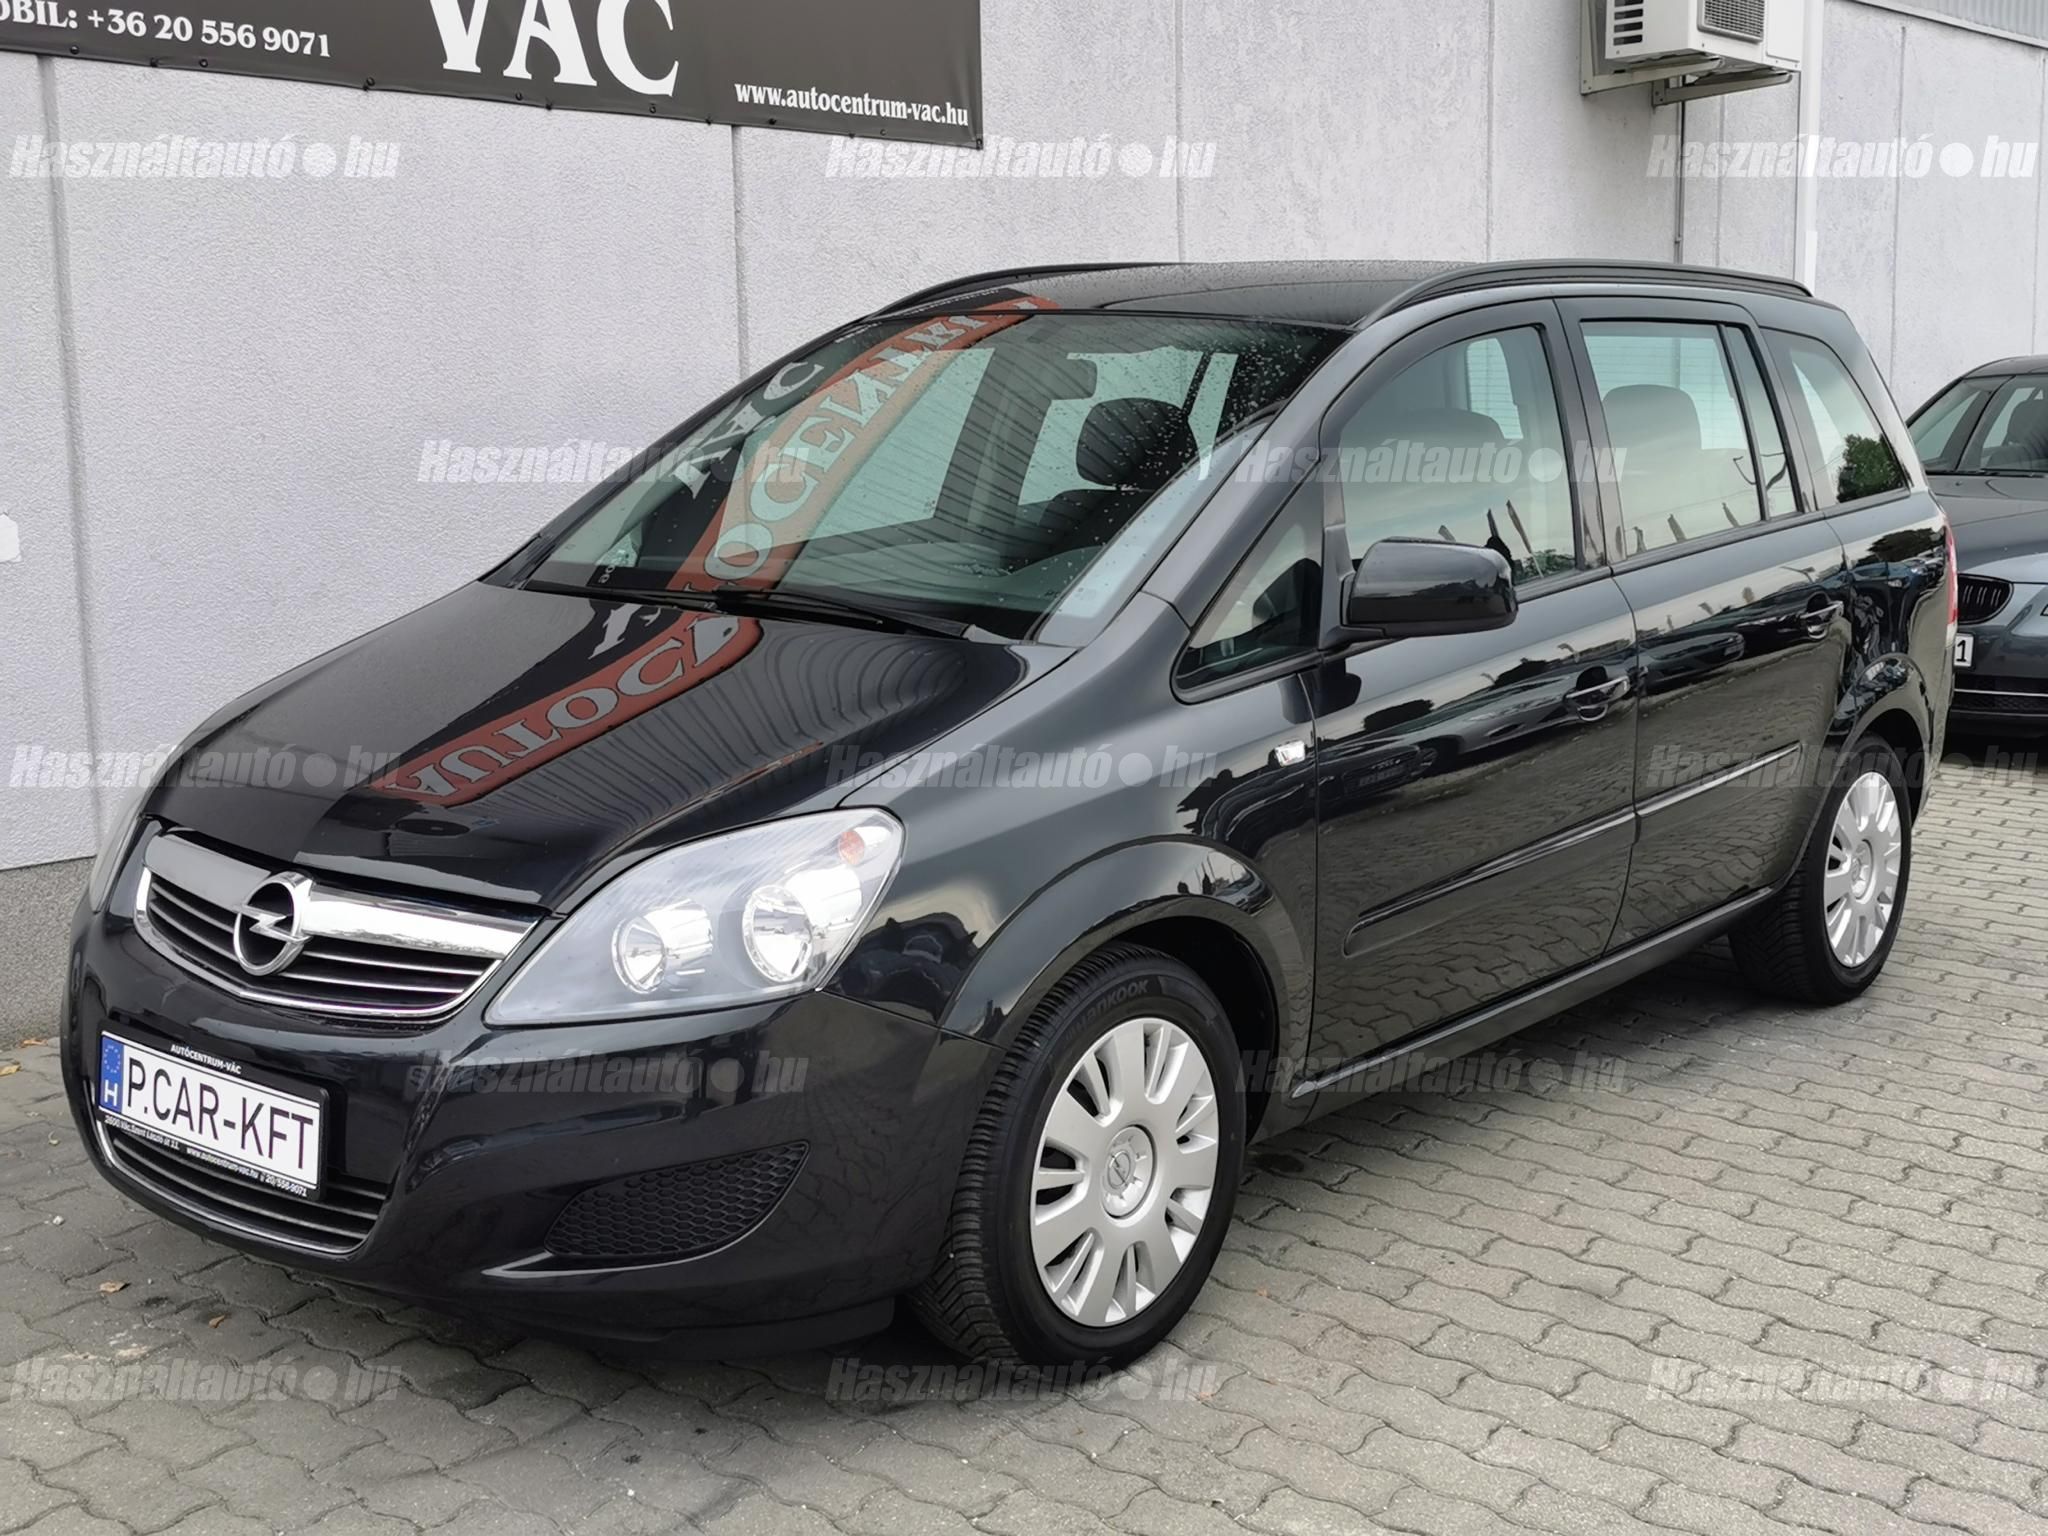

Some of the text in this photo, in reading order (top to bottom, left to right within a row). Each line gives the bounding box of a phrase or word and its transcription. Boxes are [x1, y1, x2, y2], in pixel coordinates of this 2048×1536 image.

[87, 8, 147, 37] +36
[153, 14, 193, 42] 20
[201, 19, 257, 49] 556
[262, 26, 331, 58] 9071
[734, 83, 969, 126] www.autocentrum-vac.hu
[103, 1079, 119, 1107] H
[127, 1056, 314, 1170] P.CAR-KFT
